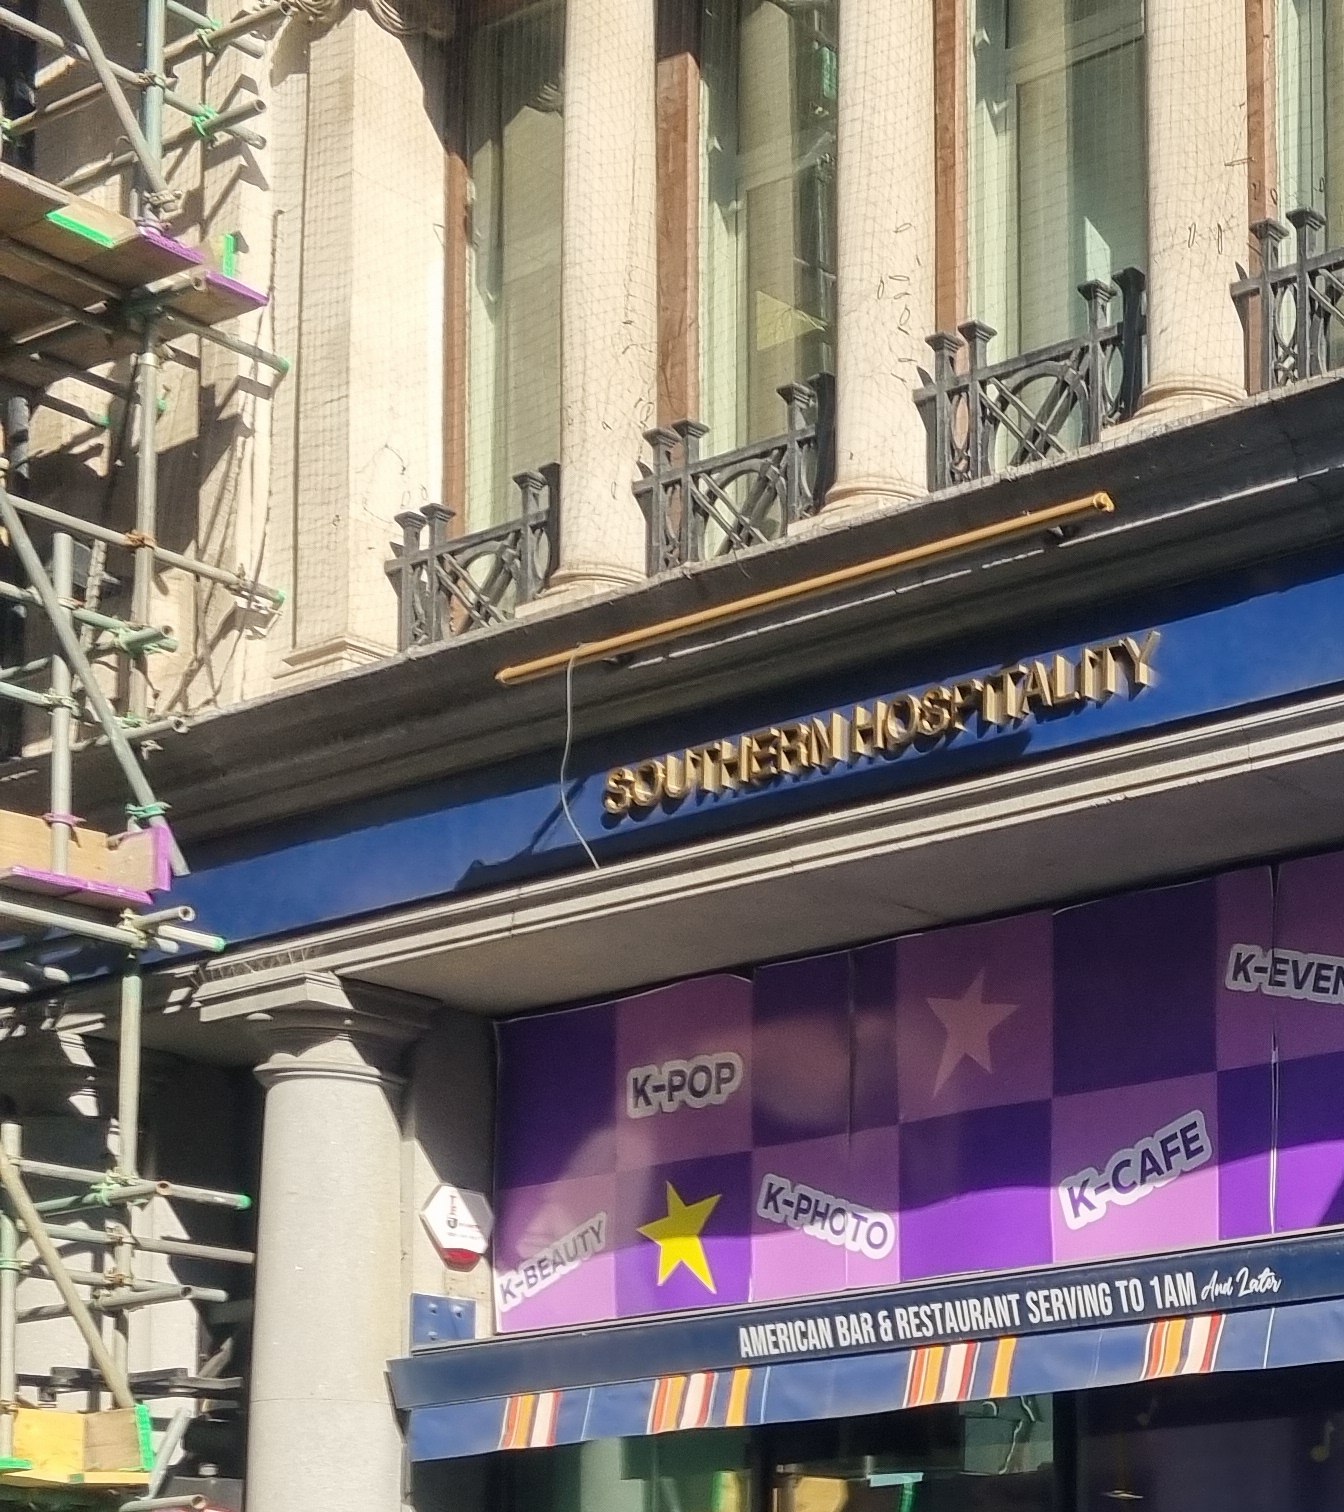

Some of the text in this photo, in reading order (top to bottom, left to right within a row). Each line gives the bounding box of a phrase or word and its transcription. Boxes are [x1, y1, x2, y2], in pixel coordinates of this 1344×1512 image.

[604, 630, 1162, 814] SOUTHERN HOSPITALITY
[631, 1060, 737, 1109] K-POP
[1066, 1120, 1206, 1218] K-CAFE
[500, 1218, 606, 1305] K-BEAUTY
[762, 1181, 889, 1252] K-PHOTO
[739, 1266, 1283, 1359] AMERICAN BAR & RESTAURANT SERVING TO 1AM And Later
